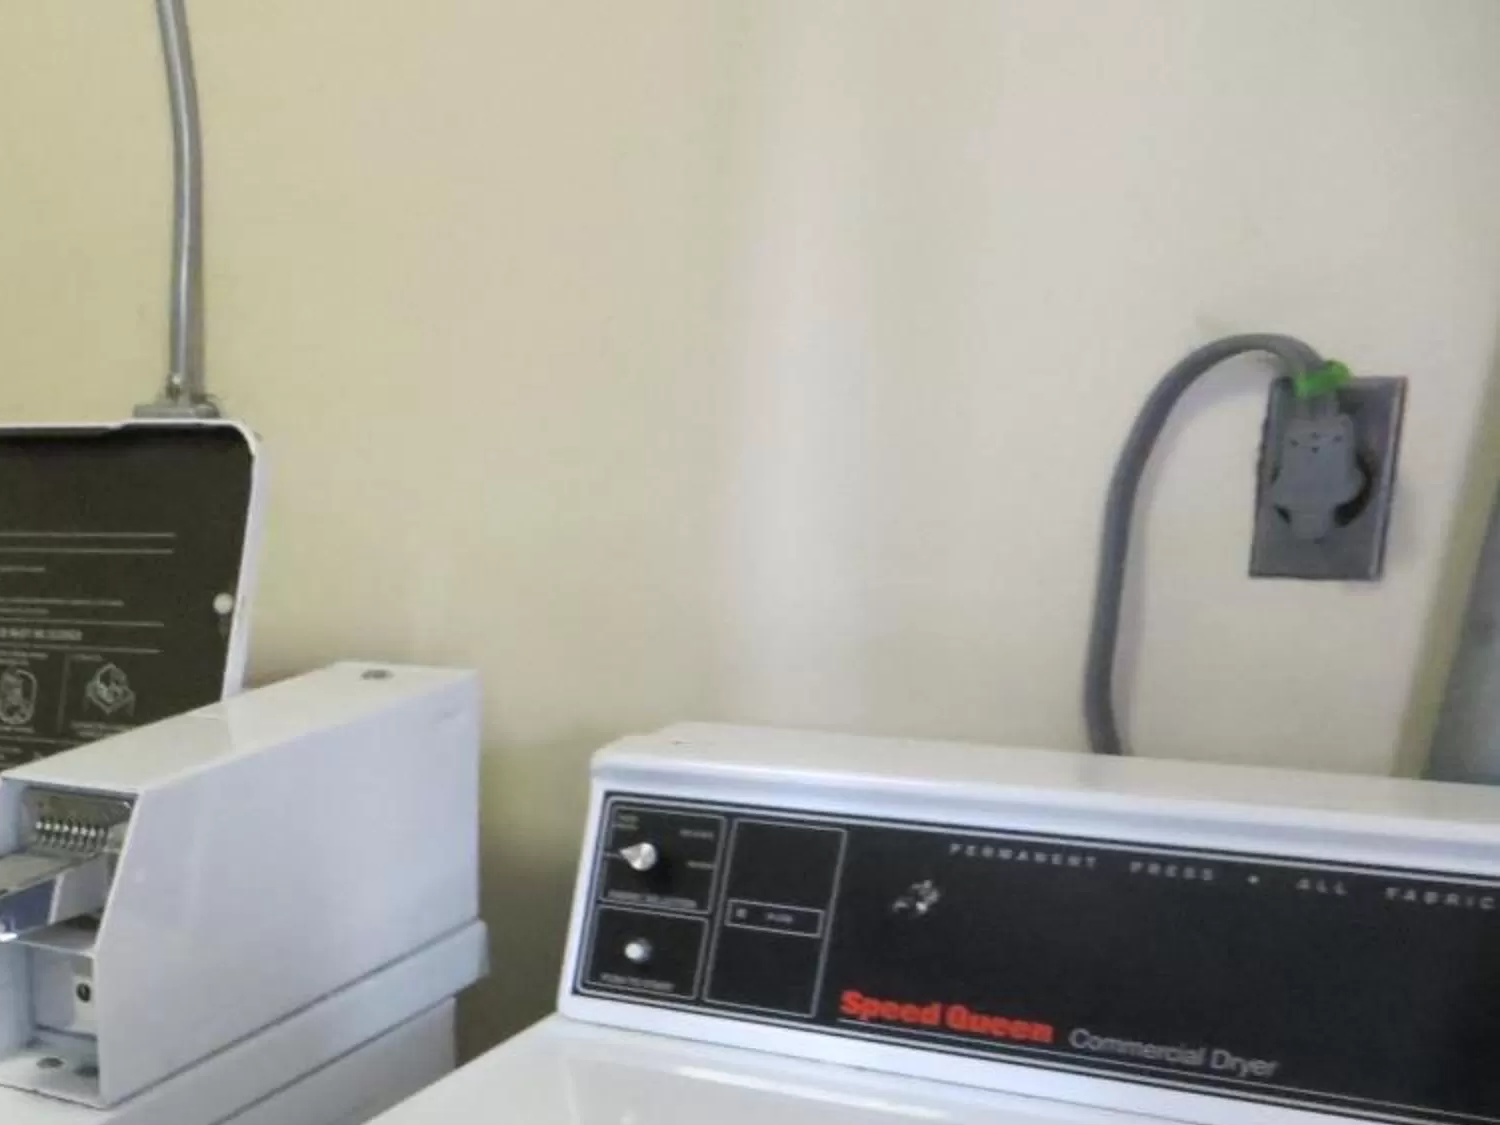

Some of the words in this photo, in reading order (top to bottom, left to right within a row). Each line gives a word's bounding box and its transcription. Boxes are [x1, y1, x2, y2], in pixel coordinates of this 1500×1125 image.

[1129, 861, 1213, 881] PRESS
[1296, 878, 1347, 895] ALL
[841, 990, 941, 1022] Speed
[946, 1005, 1053, 1043] Queen
[1068, 1028, 1206, 1066] Commercial
[1211, 1048, 1279, 1078] Dryer
